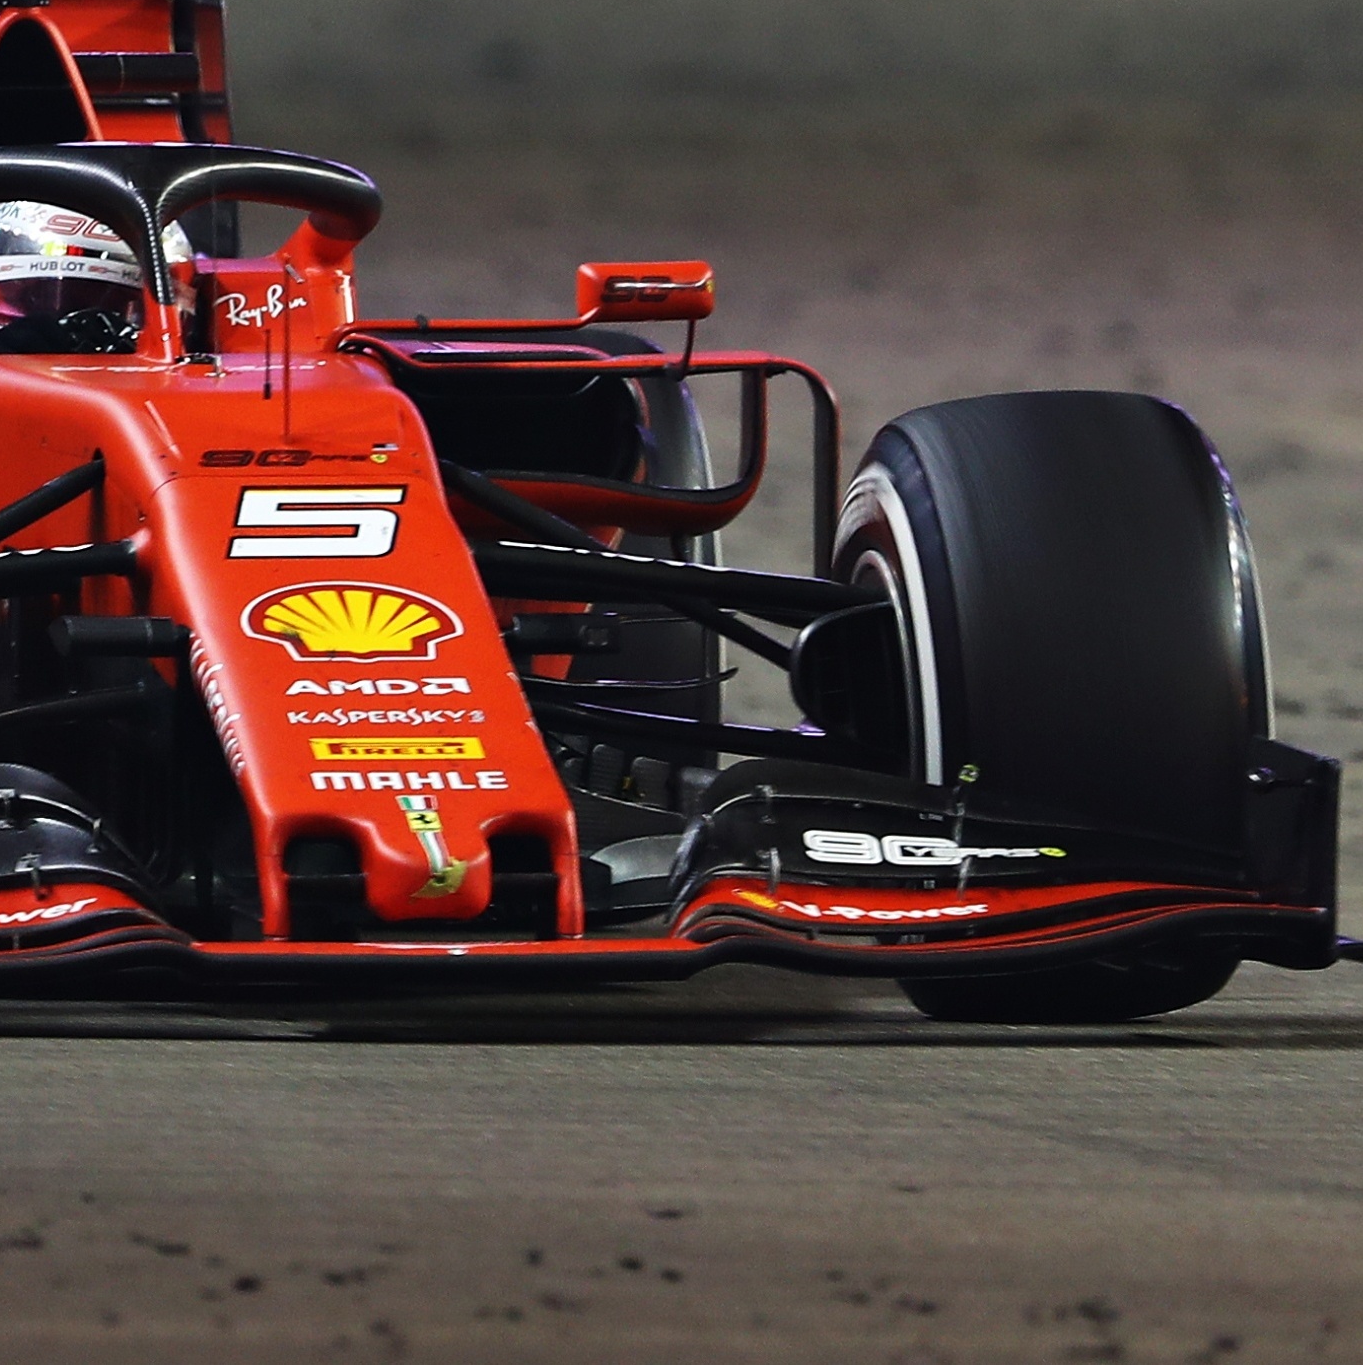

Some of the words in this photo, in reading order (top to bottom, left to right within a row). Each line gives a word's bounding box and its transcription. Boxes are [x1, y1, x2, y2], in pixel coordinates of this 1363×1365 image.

[30, 261, 86, 272] HUBLOT
[226, 485, 408, 559] 5
[286, 679, 420, 696] AMD
[287, 708, 467, 726] KASPERSKY
[328, 742, 465, 755] PIRELLI
[310, 771, 510, 790] MAHLE
[802, 829, 963, 866] 90
[780, 899, 989, 920] V-Power
